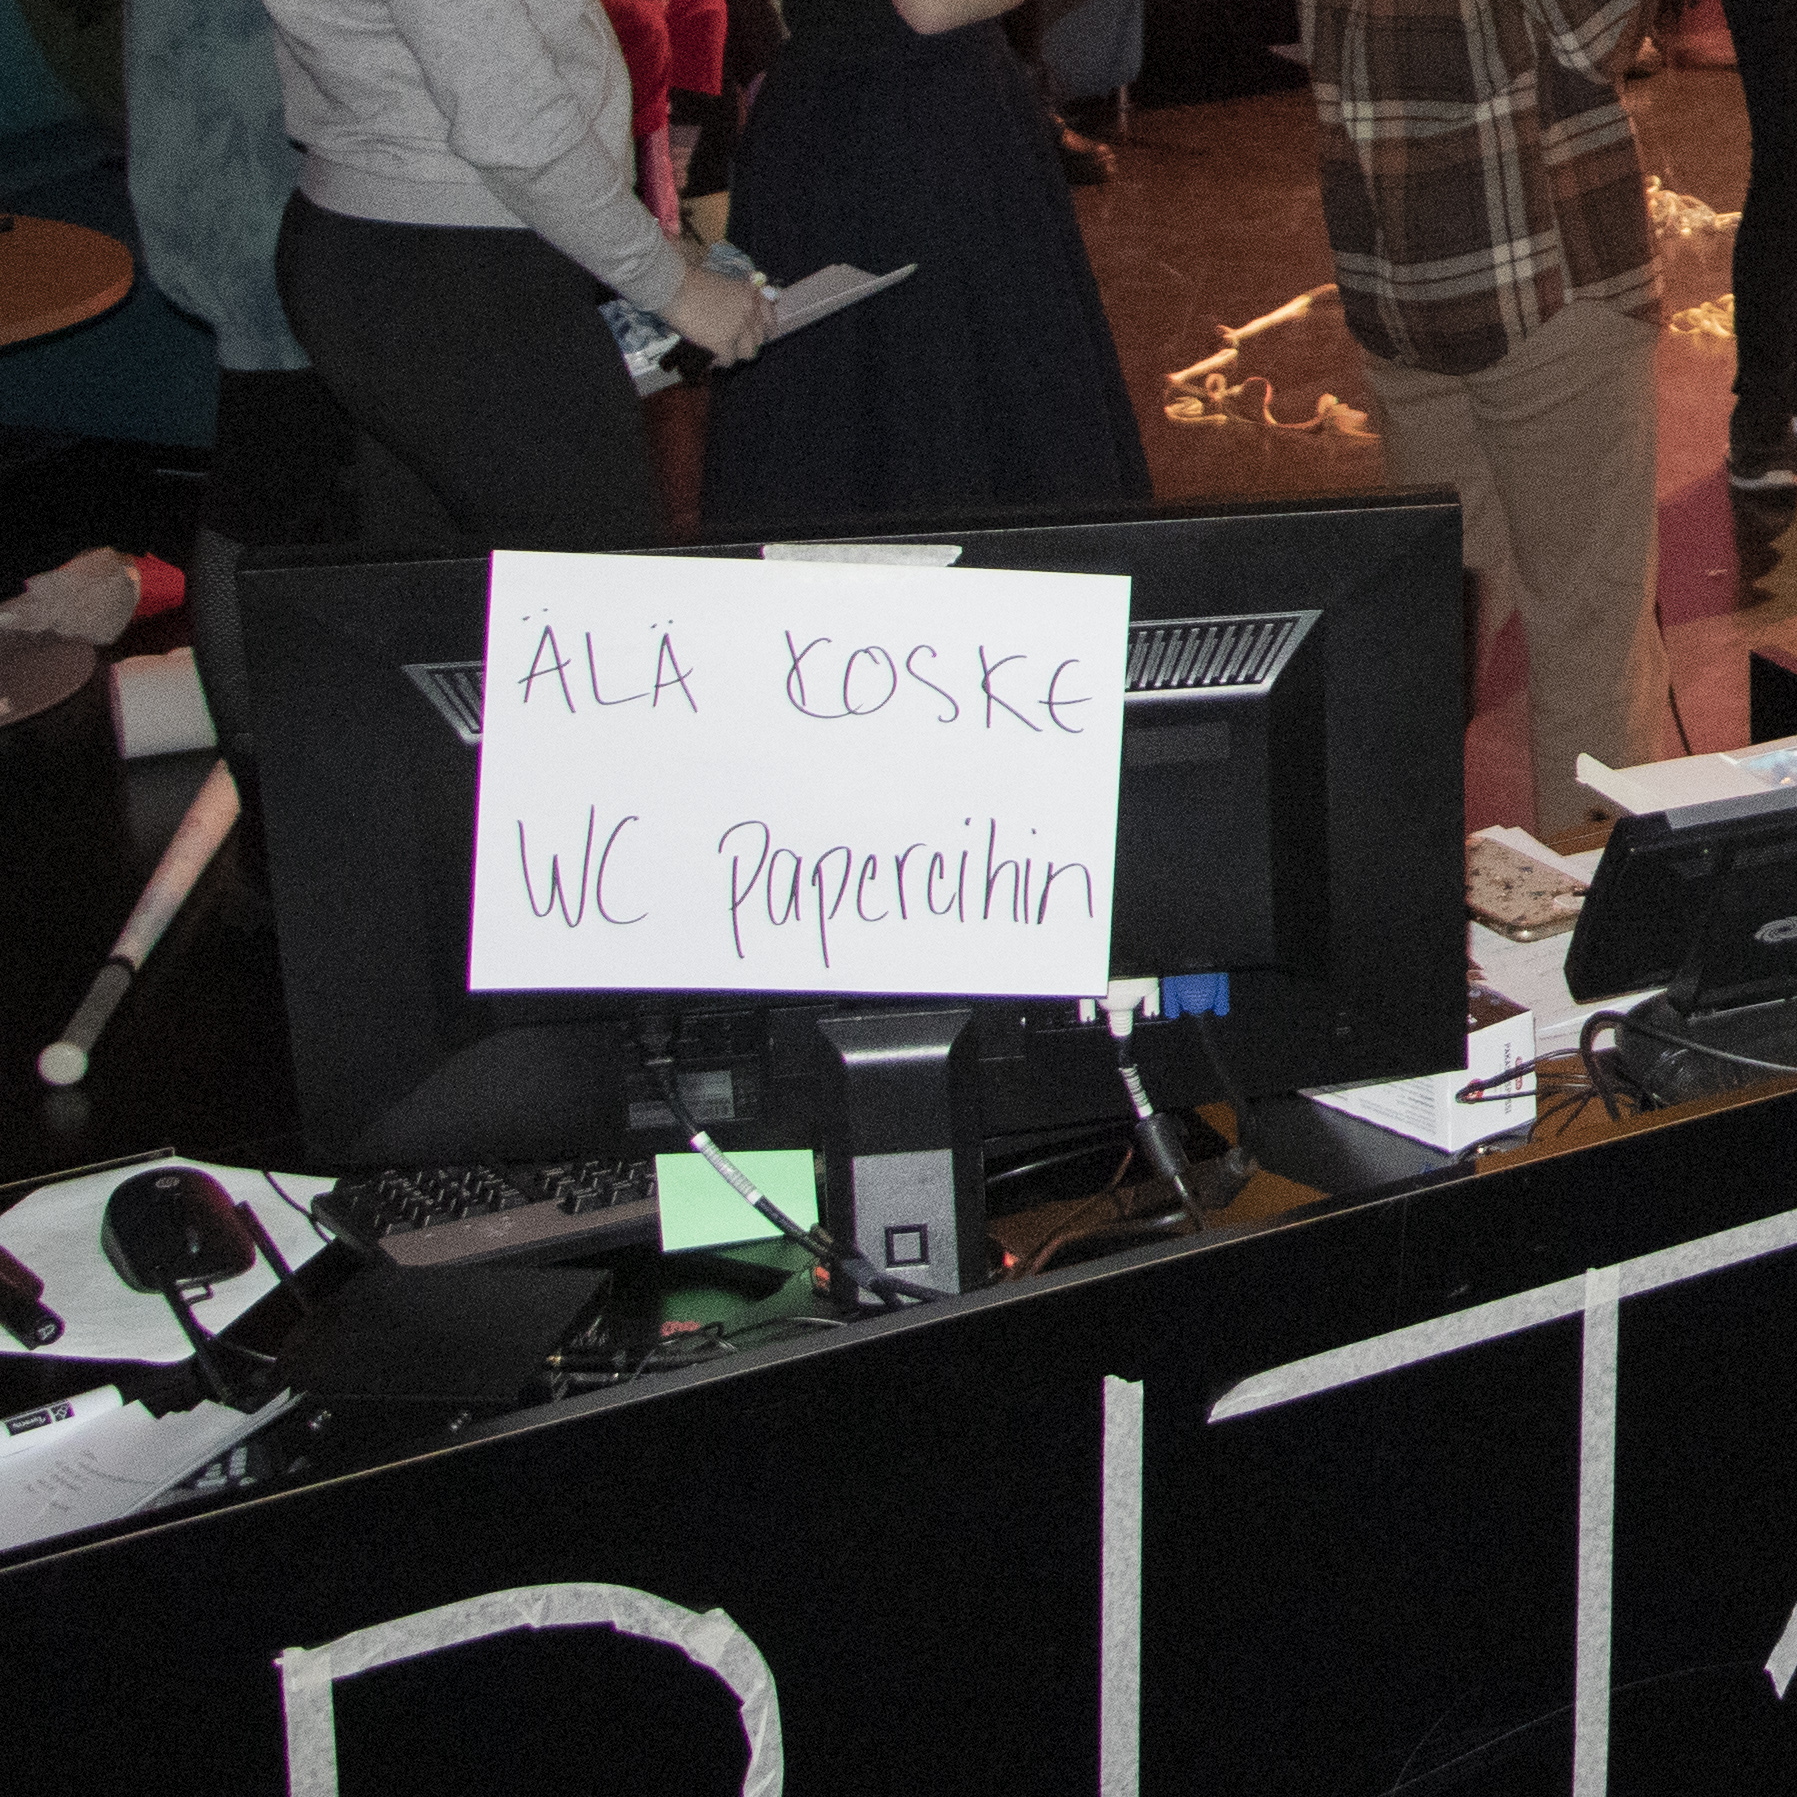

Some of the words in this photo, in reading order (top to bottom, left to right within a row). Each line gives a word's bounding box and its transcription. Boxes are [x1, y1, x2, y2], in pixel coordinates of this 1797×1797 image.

[518, 608, 697, 714] ÄLÄ
[784, 630, 1093, 733] KOSKE
[517, 803, 650, 928] WC
